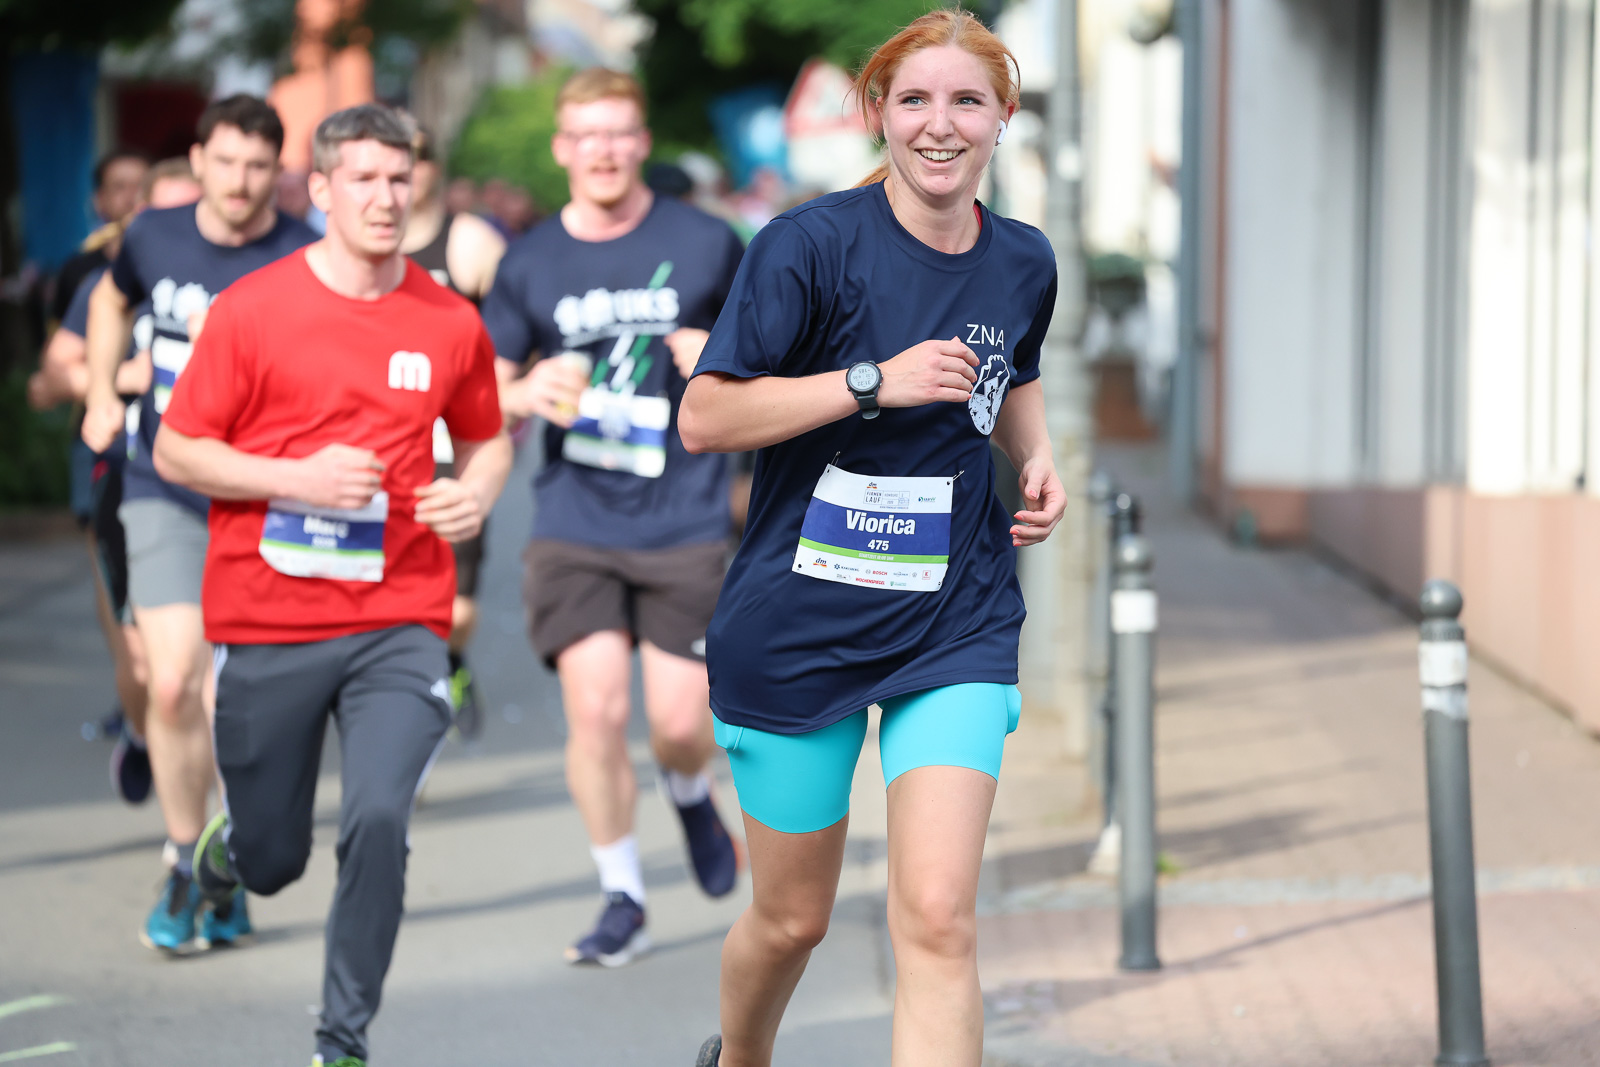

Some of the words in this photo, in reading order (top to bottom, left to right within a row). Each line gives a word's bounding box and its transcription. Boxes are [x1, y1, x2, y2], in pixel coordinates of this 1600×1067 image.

[966, 323, 1005, 351] ZNA
[846, 509, 916, 535] Viorica
[867, 539, 890, 551] 475
[814, 557, 827, 566] dm
